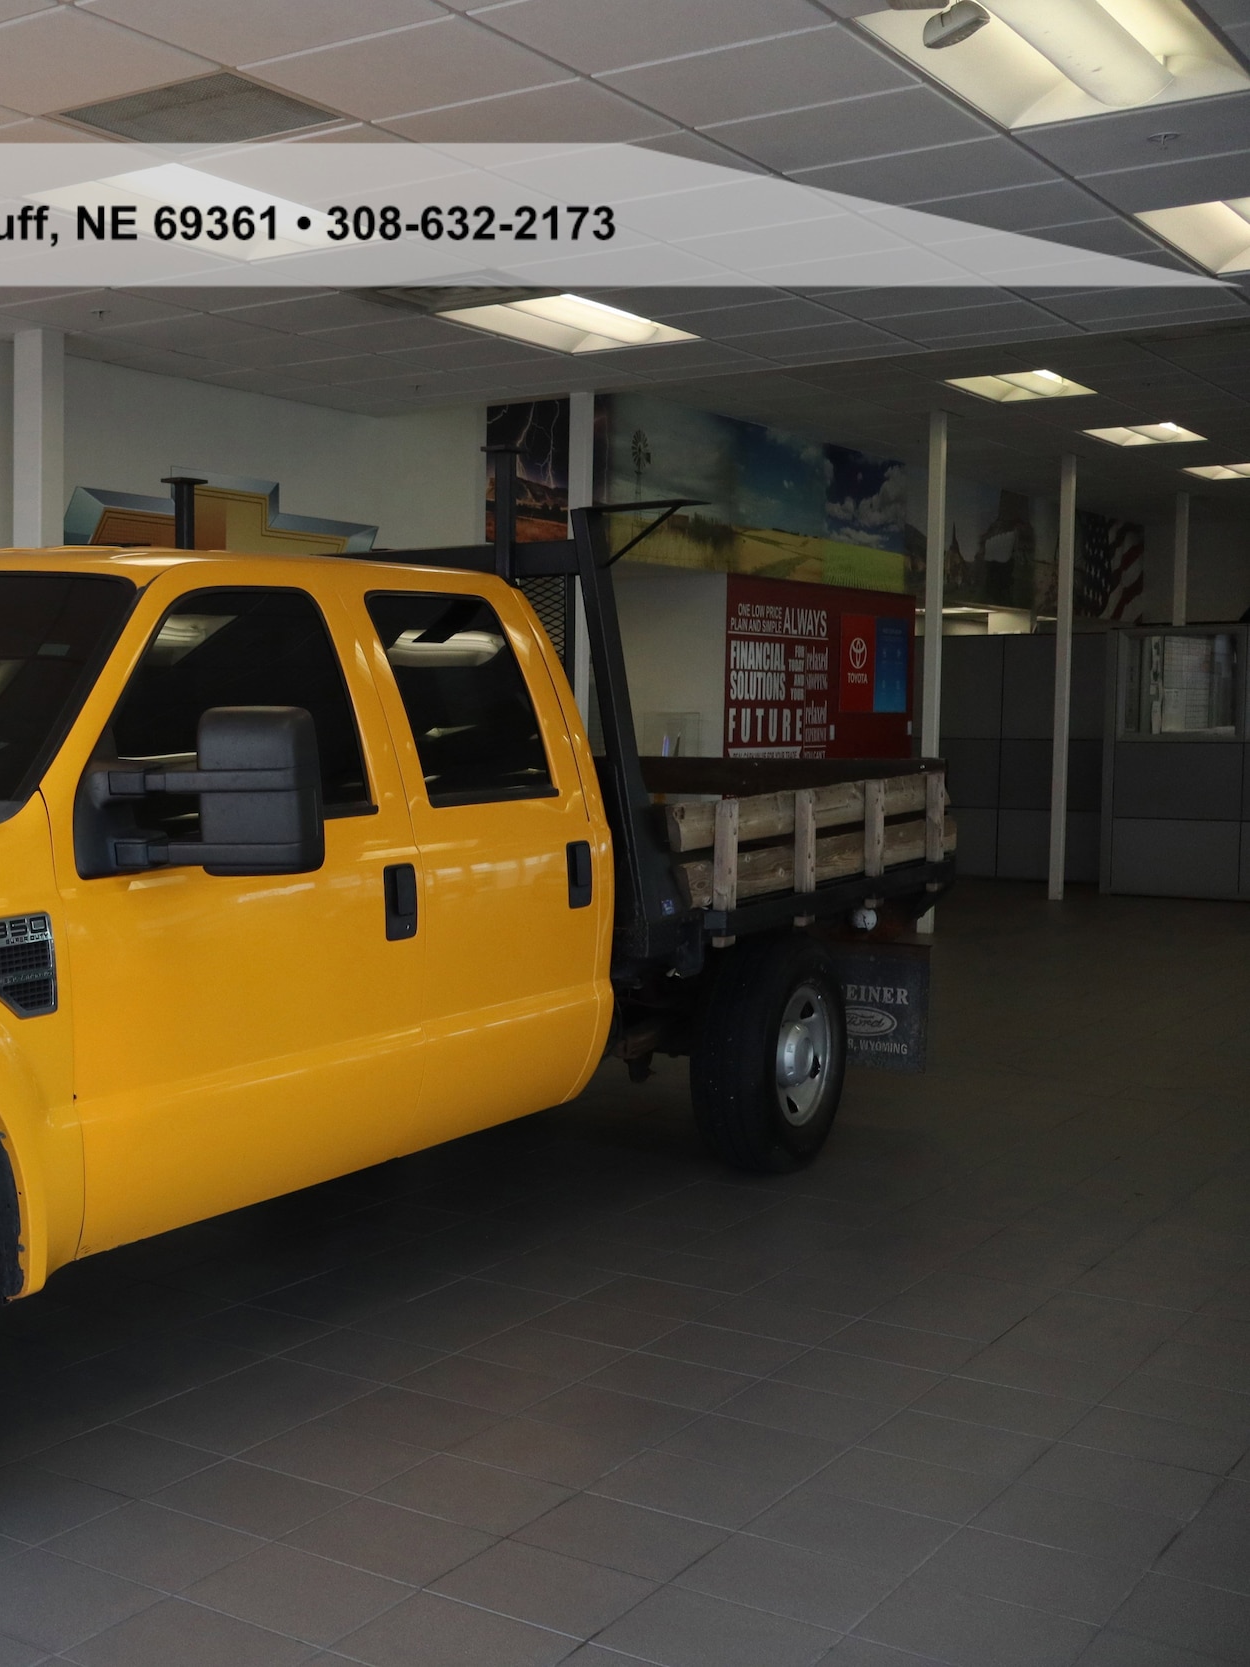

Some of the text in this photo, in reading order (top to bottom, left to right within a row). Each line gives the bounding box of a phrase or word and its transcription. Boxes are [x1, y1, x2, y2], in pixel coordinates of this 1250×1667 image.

[738, 603, 782, 619] ONE LOW PRICE
[730, 617, 782, 634] PLAIN AND SIMPLE
[783, 607, 828, 638] ALWAYS
[730, 640, 786, 671] FINANCIAL
[806, 647, 828, 671] relaxed
[730, 670, 786, 701] SOLUTIONS
[848, 672, 868, 684] TOYOTA
[805, 700, 827, 725] relaxed
[728, 707, 803, 743] FUTURE
[31, 933, 49, 941] DUTY
[841, 984, 909, 1005] EINER
[860, 1040, 908, 1055] WYOMING
